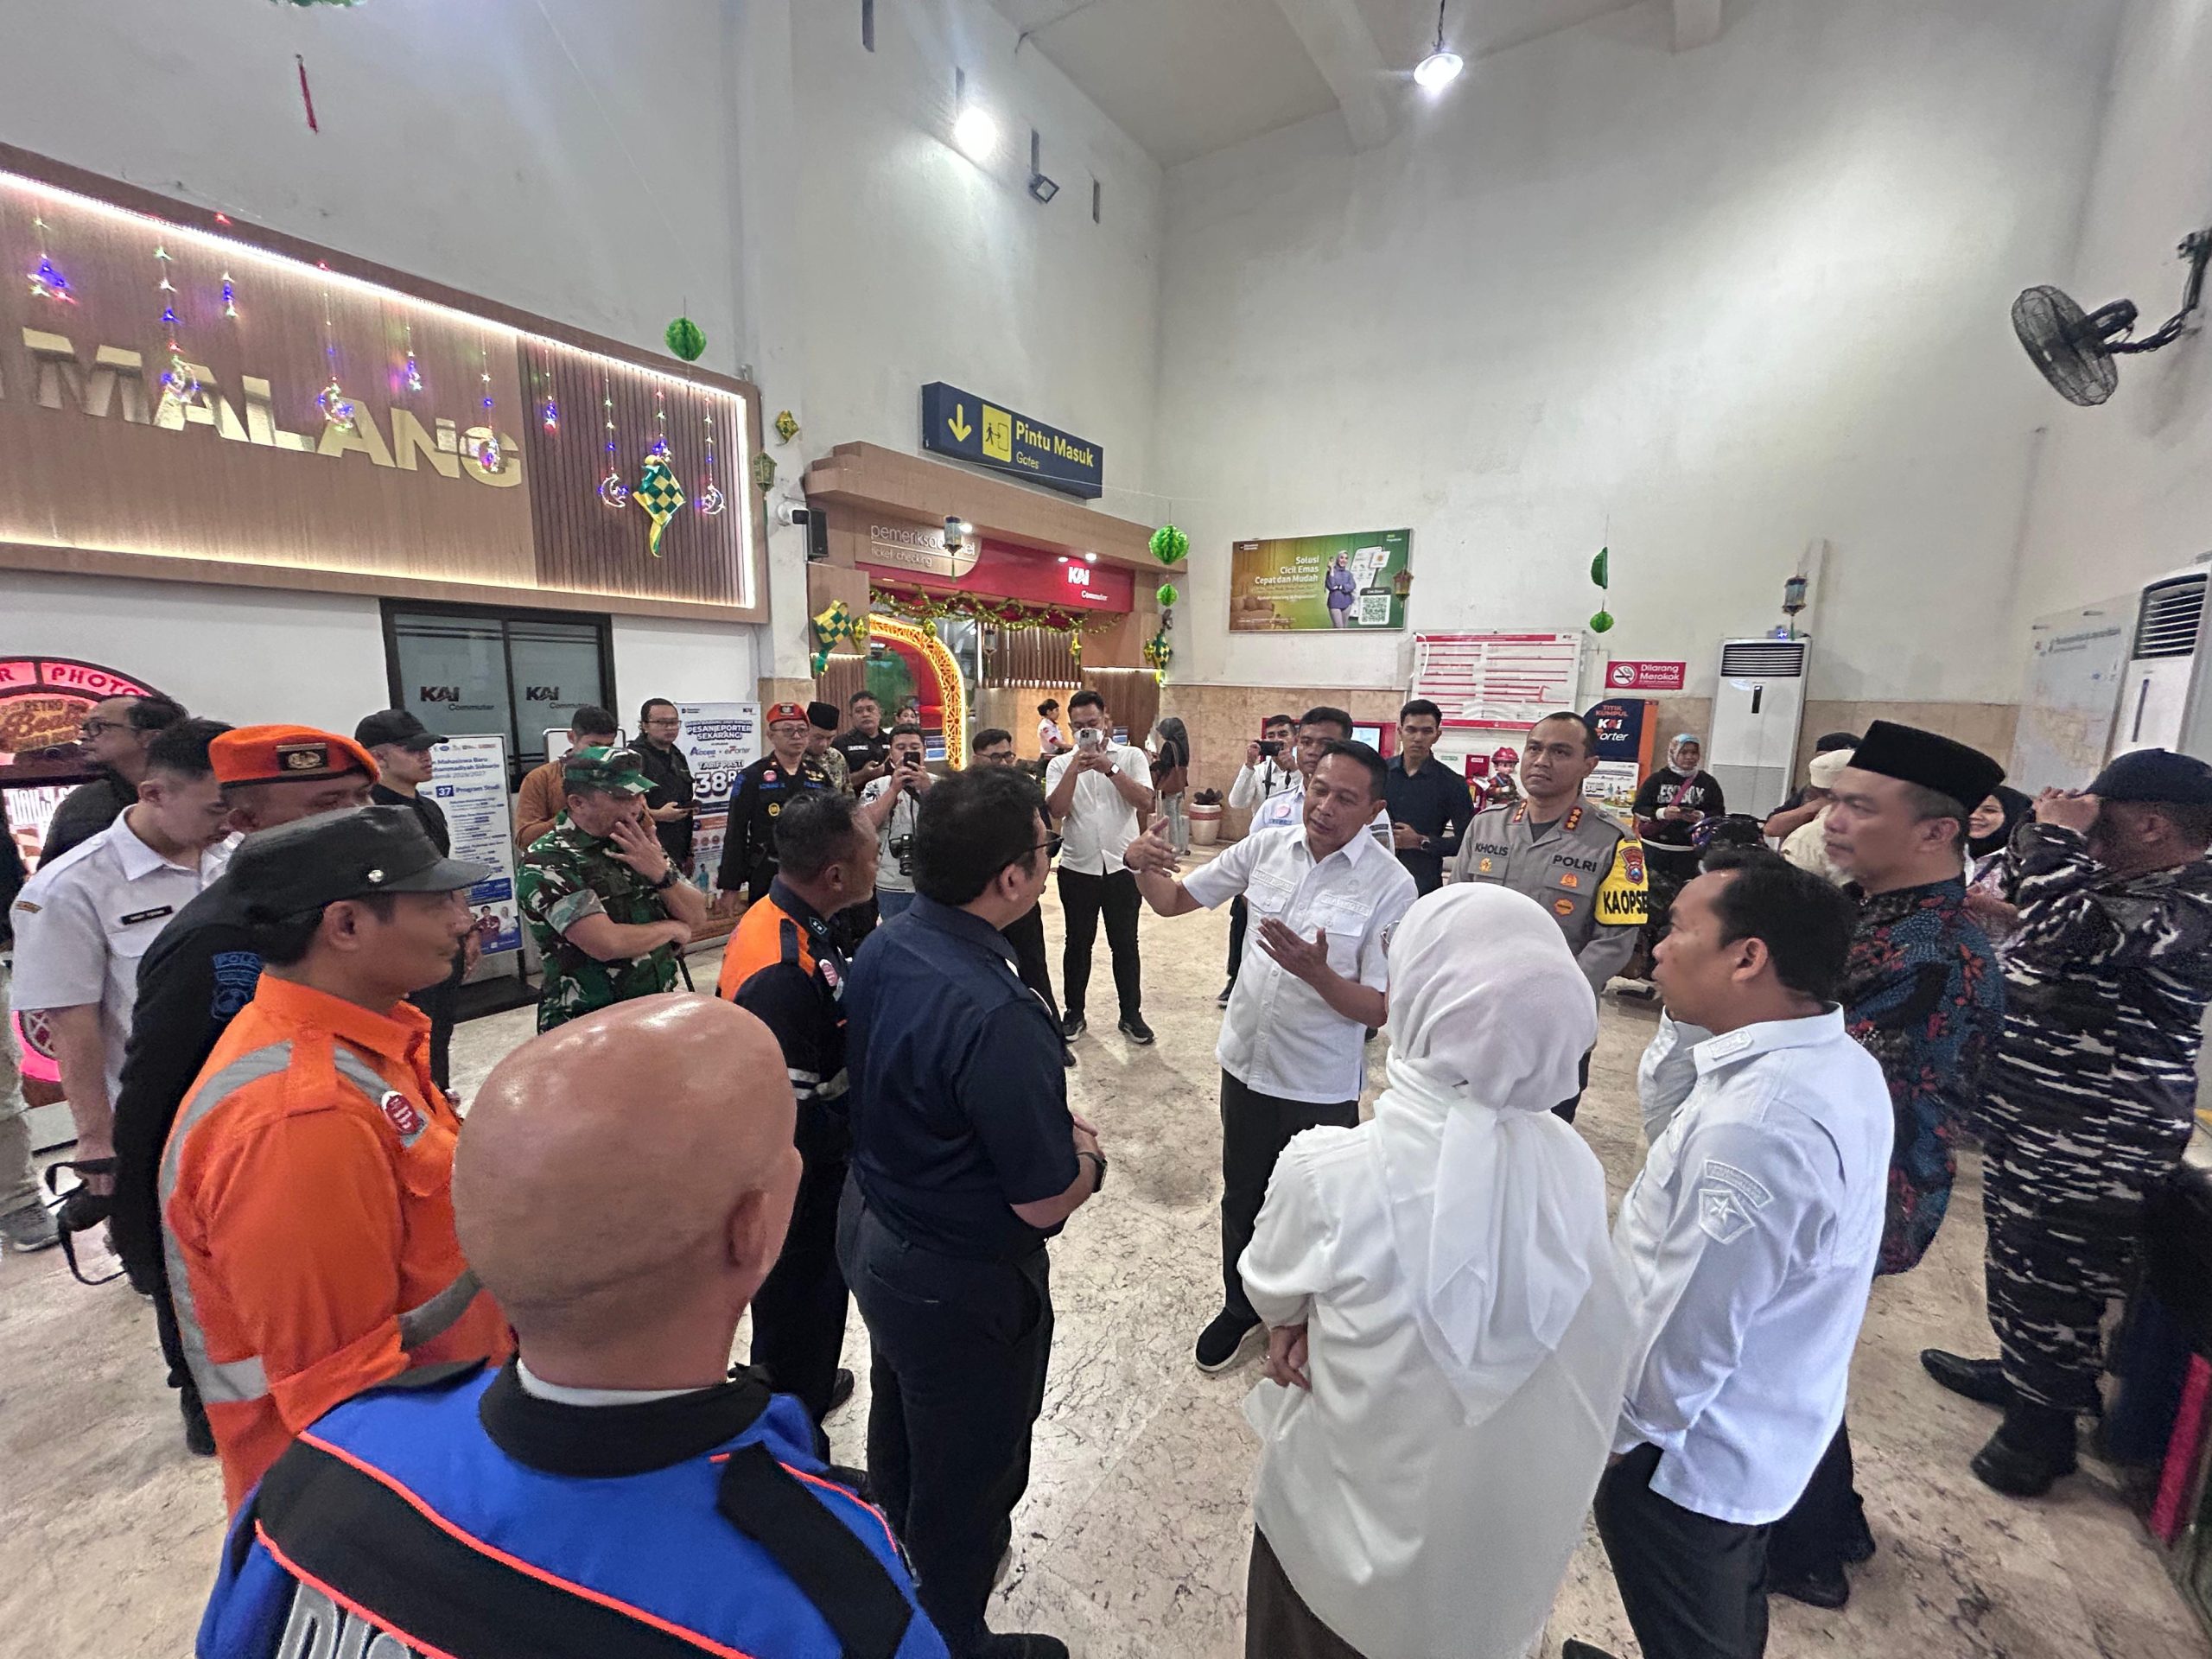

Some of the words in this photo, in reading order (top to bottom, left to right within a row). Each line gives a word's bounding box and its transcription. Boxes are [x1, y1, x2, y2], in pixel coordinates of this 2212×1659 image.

[22, 327, 522, 487] MALANG
[1016, 420, 1051, 451] Pintu
[1054, 435, 1094, 467] Masuk
[1016, 451, 1040, 469] Gates
[870, 524, 946, 550] pemeriksaa
[871, 546, 893, 559] ticket
[896, 550, 932, 568] checking
[1295, 555, 1319, 564] Solusi
[1068, 566, 1090, 586] KAI
[1255, 576, 1276, 585] Cepat
[1277, 575, 1291, 583] dan
[1292, 574, 1318, 583] Mudah
[1641, 664, 1679, 673] Dilarang
[420, 686, 460, 702] KAI
[526, 686, 560, 701] KAI
[687, 725, 715, 734] PESAN
[715, 724, 753, 733] EPORTER
[438, 787, 452, 796] 37
[1474, 842, 1509, 856] KHOLIS
[1553, 855, 1597, 873] POLRI
